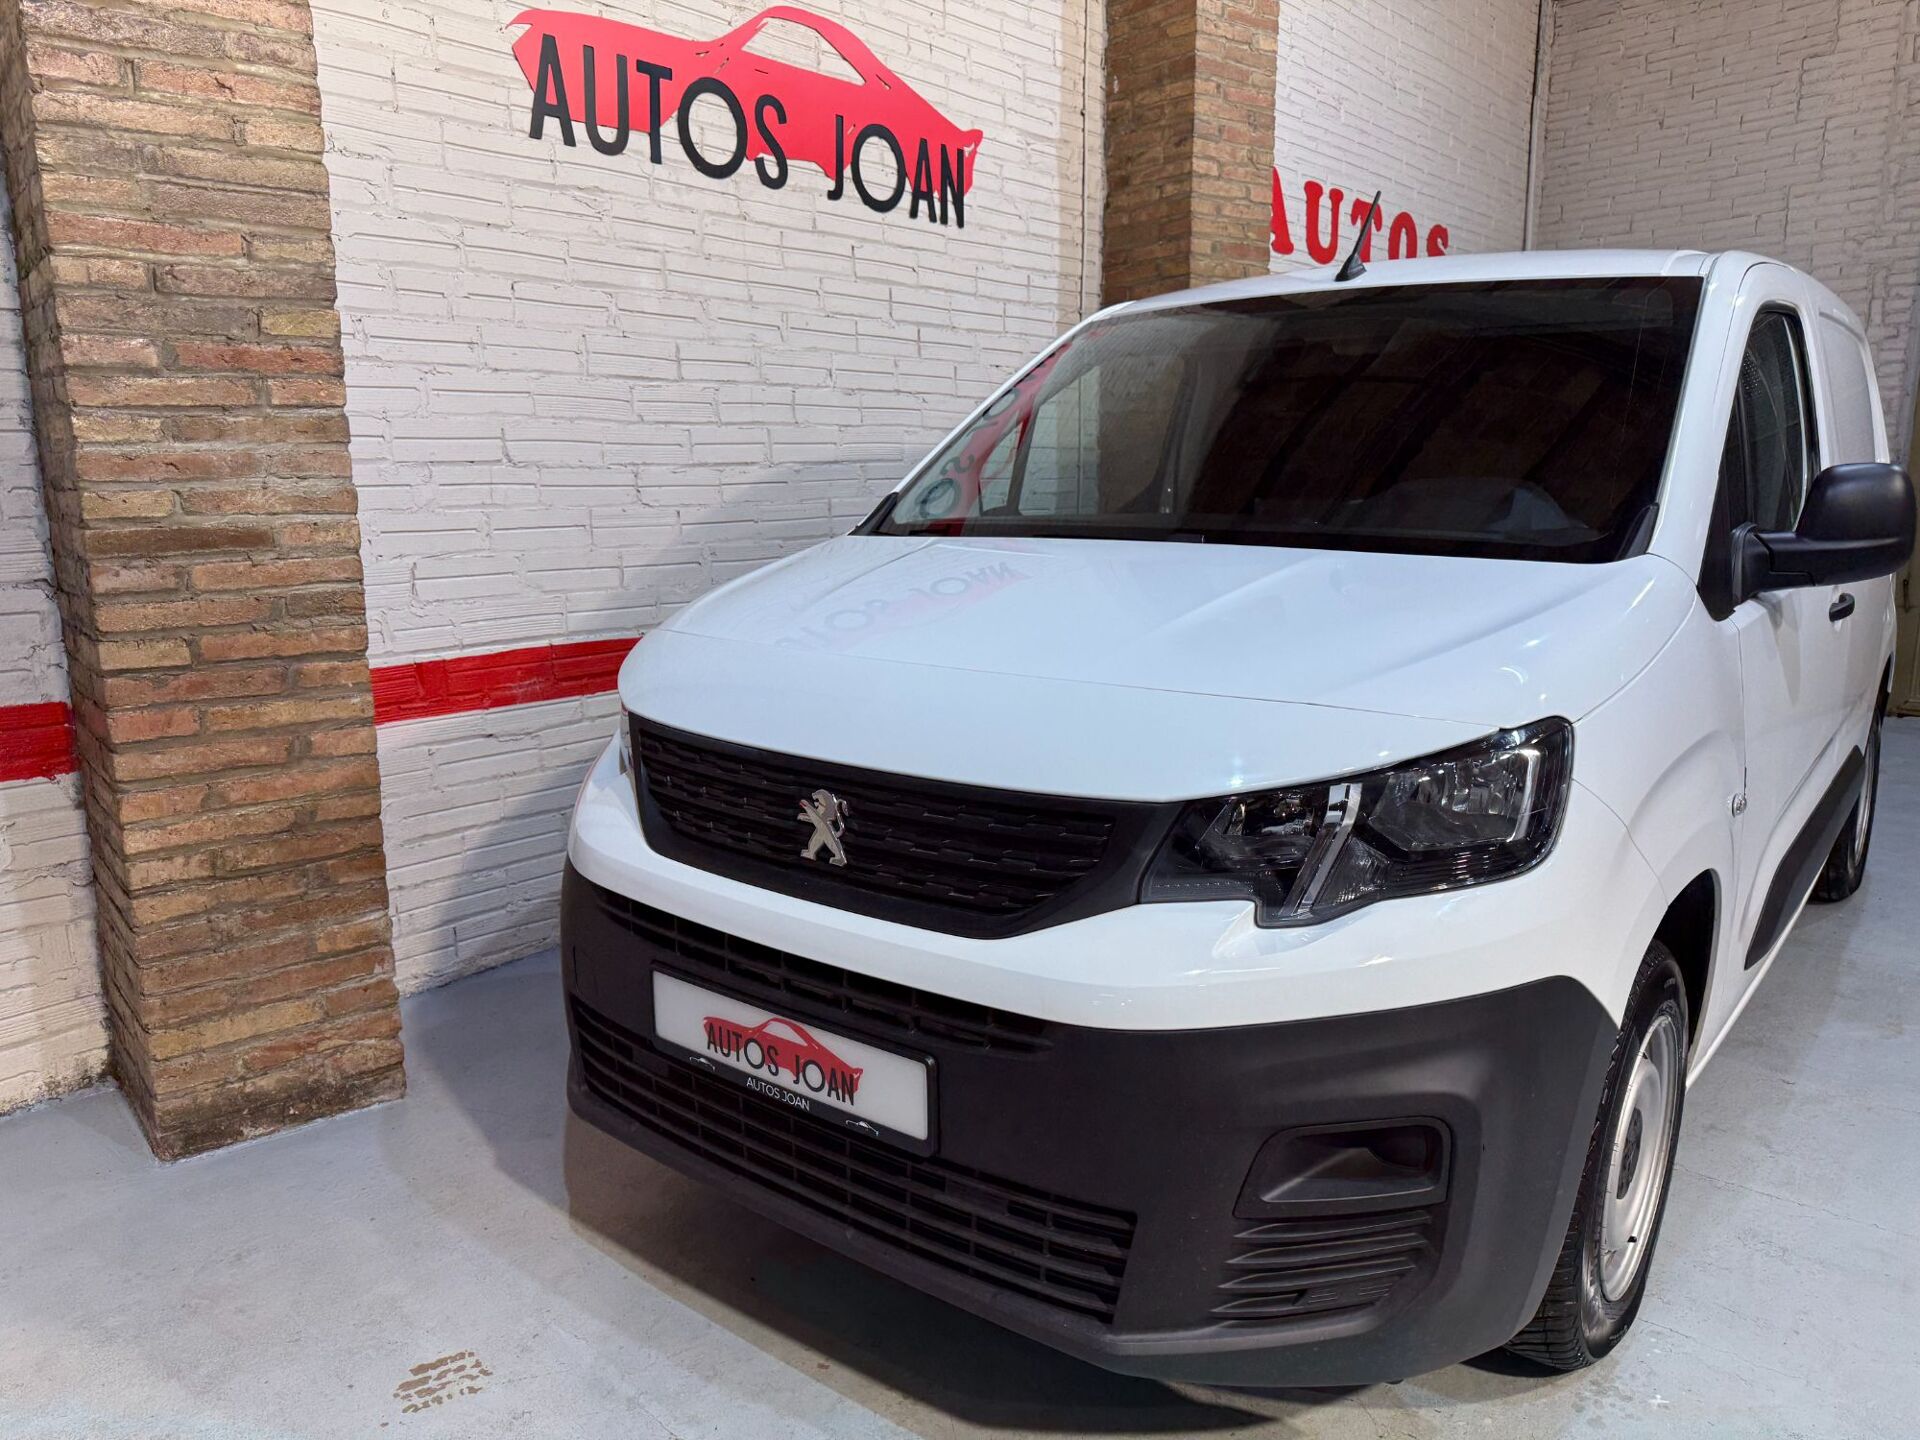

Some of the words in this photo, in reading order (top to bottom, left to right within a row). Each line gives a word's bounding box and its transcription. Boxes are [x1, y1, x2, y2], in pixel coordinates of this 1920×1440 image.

[529, 34, 788, 190] AUTOS
[827, 114, 965, 229] JOAN
[707, 1023, 779, 1076] AUTOS
[793, 1055, 855, 1106] JOAN
[746, 1077, 780, 1099] AUTOS
[782, 1090, 810, 1111] JOAN
